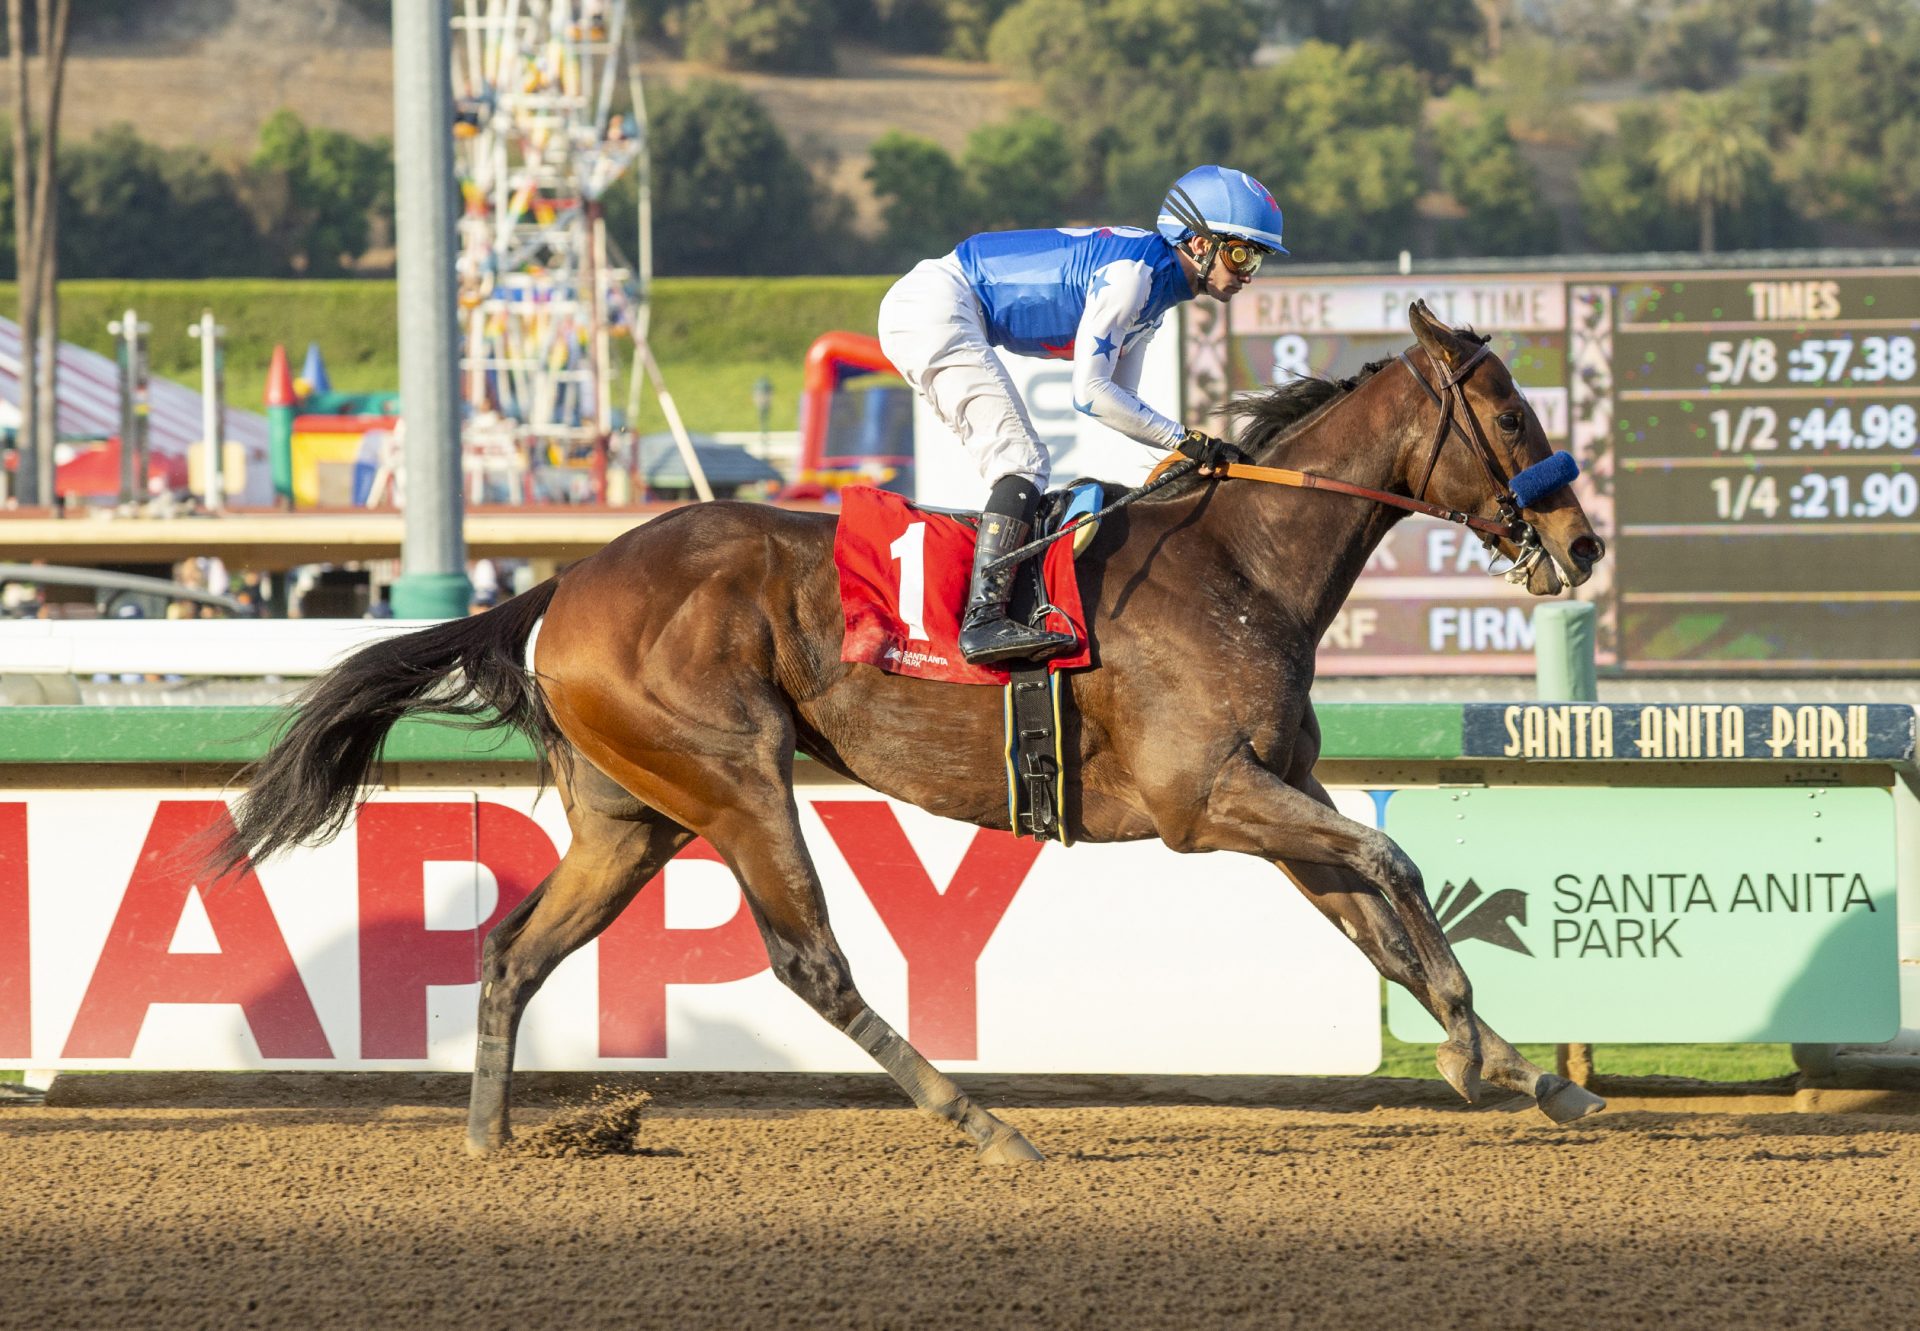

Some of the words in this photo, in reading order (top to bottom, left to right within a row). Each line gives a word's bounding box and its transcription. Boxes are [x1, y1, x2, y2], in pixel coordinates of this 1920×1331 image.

[1256, 292, 1333, 327] RACE
[1471, 289, 1544, 326] TIME
[1752, 281, 1840, 320] TIMES
[1272, 334, 1311, 385] 8
[1707, 338, 1777, 384] 5/8
[1788, 336, 1917, 382] :57.38
[1709, 406, 1778, 452] 1/2
[1789, 404, 1918, 449] :44.98
[1711, 475, 1780, 520] 1/4
[1789, 472, 1919, 518] :21.90
[1427, 527, 1516, 572] FA
[889, 521, 930, 642] 1
[1429, 606, 1536, 650] FIRM
[902, 657, 921, 668] PARK
[903, 650, 927, 663] SANTA
[927, 655, 949, 667] ANITA
[1504, 704, 1614, 758] SANTA
[1633, 704, 1745, 758] ANITA
[1764, 704, 1869, 758] PARK
[1553, 873, 1718, 914] SANTA
[1729, 872, 1877, 913] ANITA
[0, 799, 1046, 1060] APPY
[1553, 918, 1683, 958] PARK
